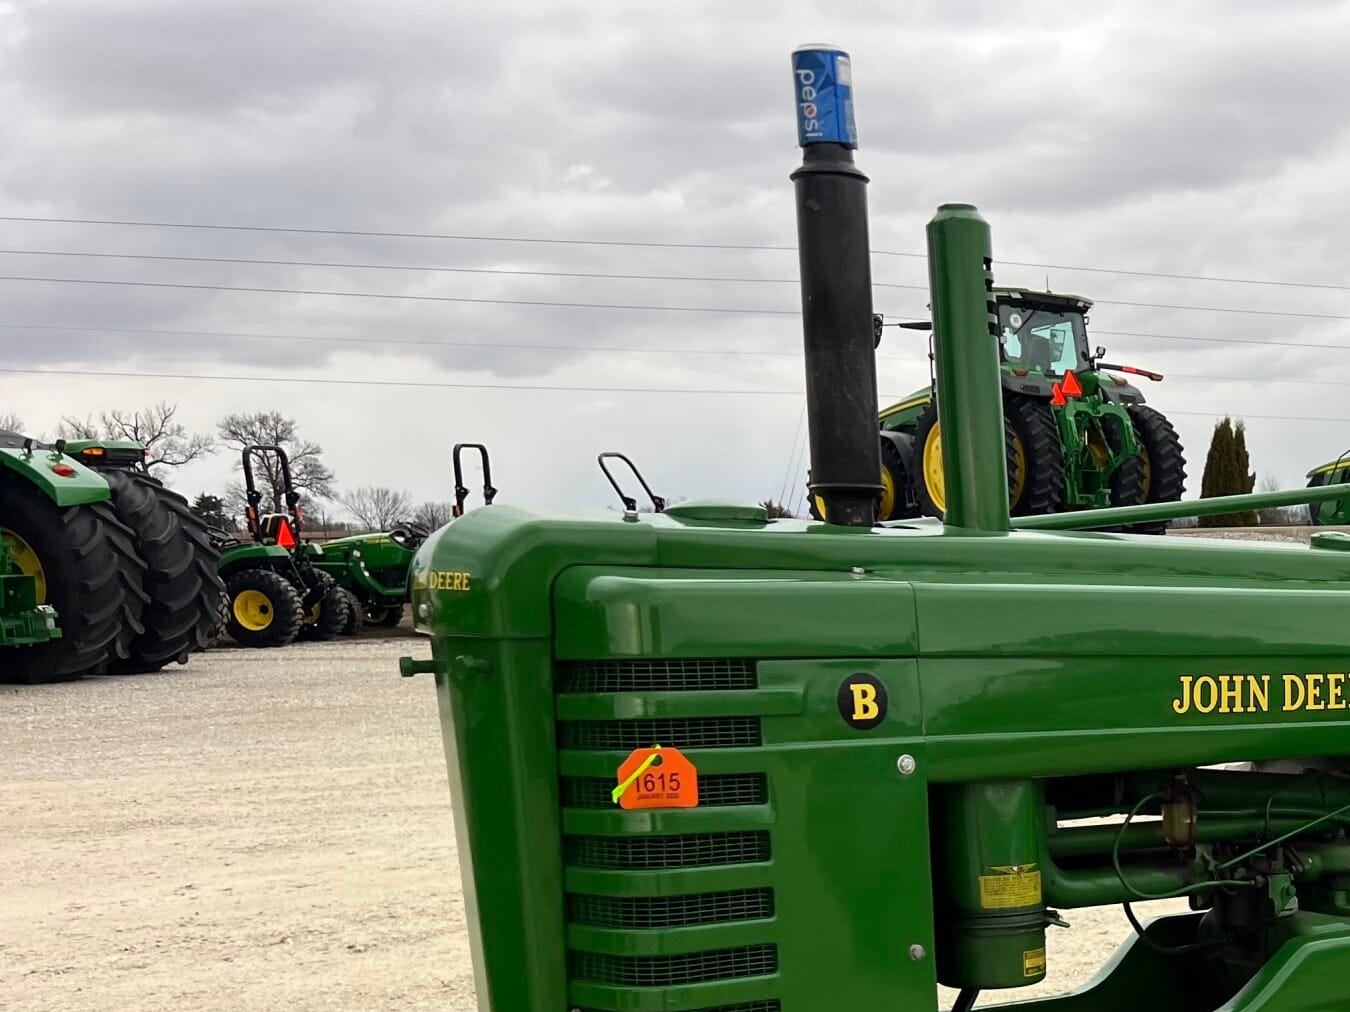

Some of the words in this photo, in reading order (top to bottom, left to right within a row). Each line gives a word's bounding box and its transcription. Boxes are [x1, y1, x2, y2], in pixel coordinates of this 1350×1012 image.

[797, 69, 823, 137] pepsi
[430, 571, 471, 591] DEERE
[850, 684, 879, 720] B
[1173, 675, 1270, 714] JOHN
[636, 772, 681, 792] 1615
